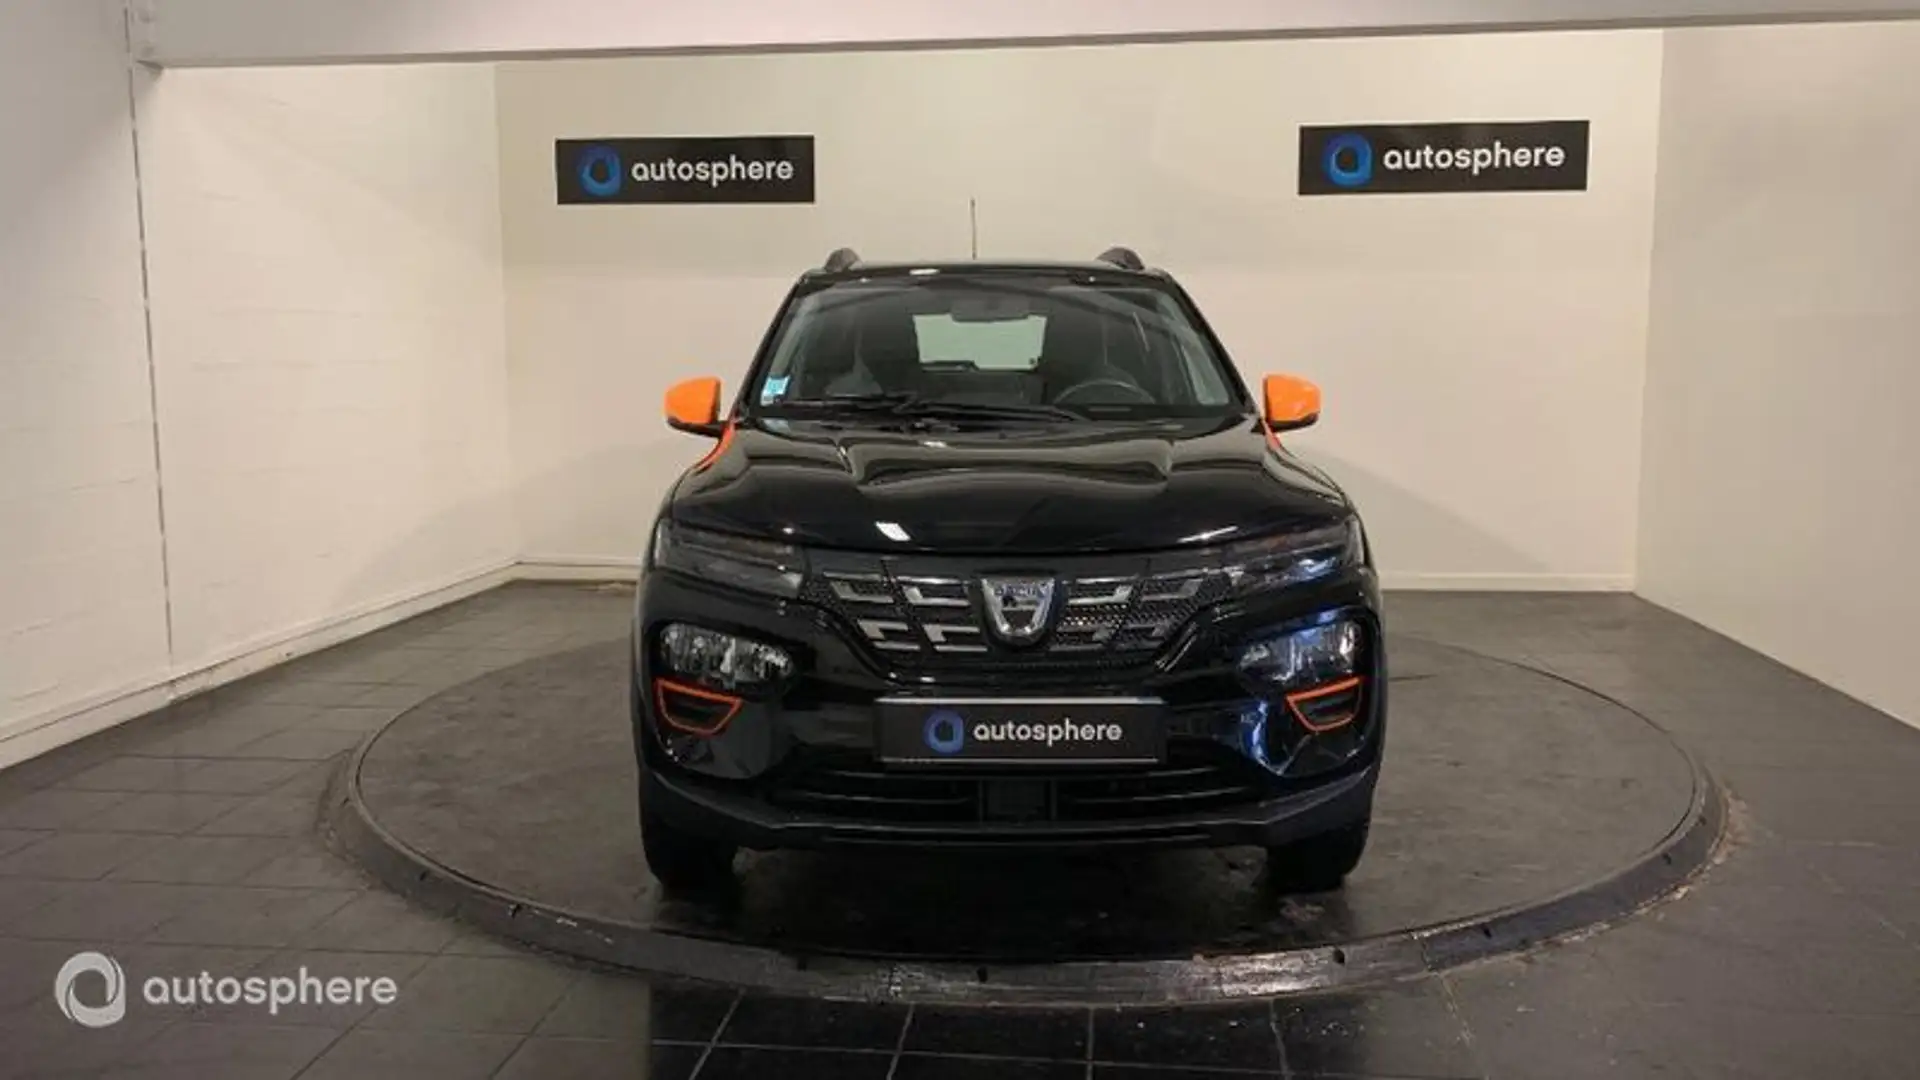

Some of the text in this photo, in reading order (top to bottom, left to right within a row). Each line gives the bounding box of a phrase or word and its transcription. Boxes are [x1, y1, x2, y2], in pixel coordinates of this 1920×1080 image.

[631, 154, 794, 187] autosphere
[1383, 141, 1566, 175] autosphere
[973, 717, 1122, 747] autosphere
